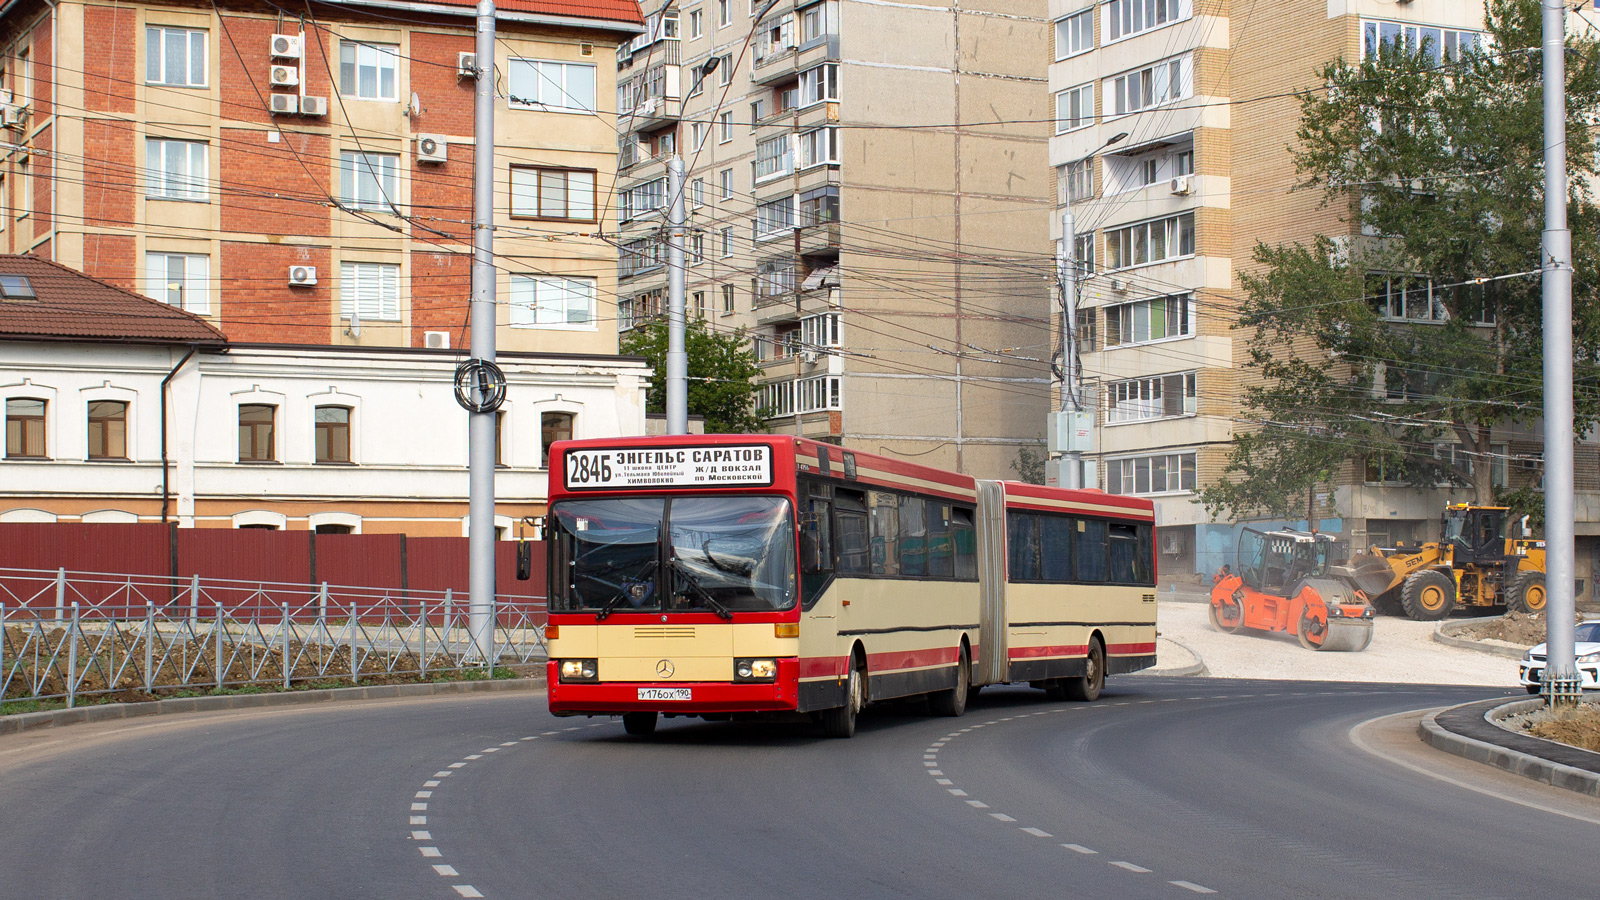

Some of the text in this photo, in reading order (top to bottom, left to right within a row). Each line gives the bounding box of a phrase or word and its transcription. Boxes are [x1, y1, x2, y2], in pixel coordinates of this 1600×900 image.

[616, 449, 763, 465] ЭНГЕЛЬС САРАТОВ
[570, 454, 612, 483] 284Б
[721, 464, 762, 472] ВОКЗАЛ
[708, 473, 763, 481] Московской
[1405, 555, 1424, 568] SEM
[676, 689, 689, 697] 190
